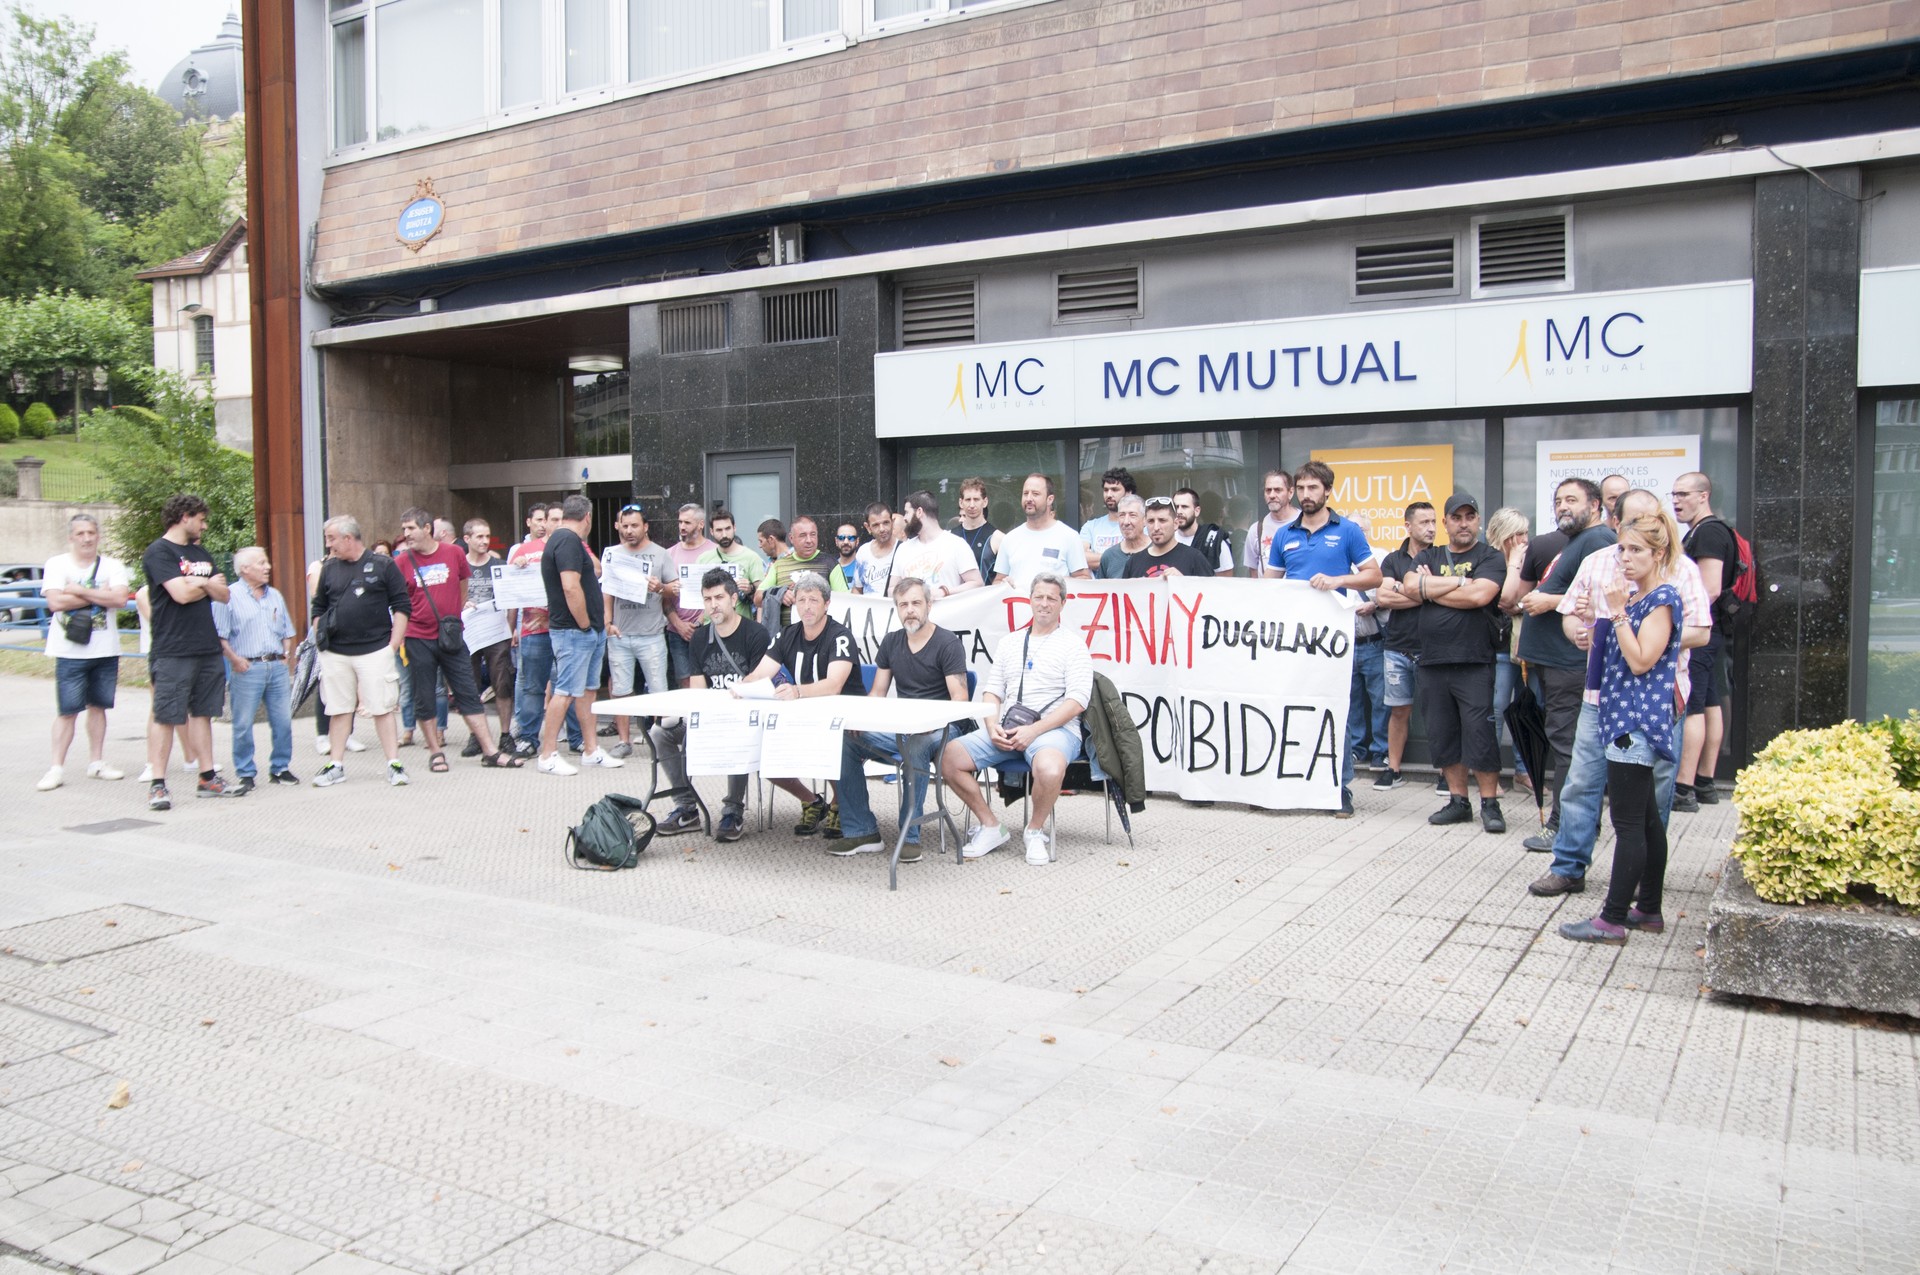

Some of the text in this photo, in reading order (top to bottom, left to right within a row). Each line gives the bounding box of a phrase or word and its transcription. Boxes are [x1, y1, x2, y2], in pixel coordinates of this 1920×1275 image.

[406, 217, 432, 229] BIHOTZA
[408, 230, 426, 238] PLAZA
[1546, 312, 1645, 362] MC
[1103, 340, 1418, 399] MC MUTUAL
[1545, 362, 1646, 376] MUTUAL
[976, 357, 1045, 398] MC
[975, 399, 1047, 411] MUTUAL
[581, 467, 589, 479] 4
[1550, 465, 1649, 478] NUESTRA MISIÓN ES
[1327, 474, 1432, 502] MUTUA
[1370, 525, 1408, 541] URID
[1201, 615, 1349, 660] DUGULAKO
[836, 635, 850, 658] R
